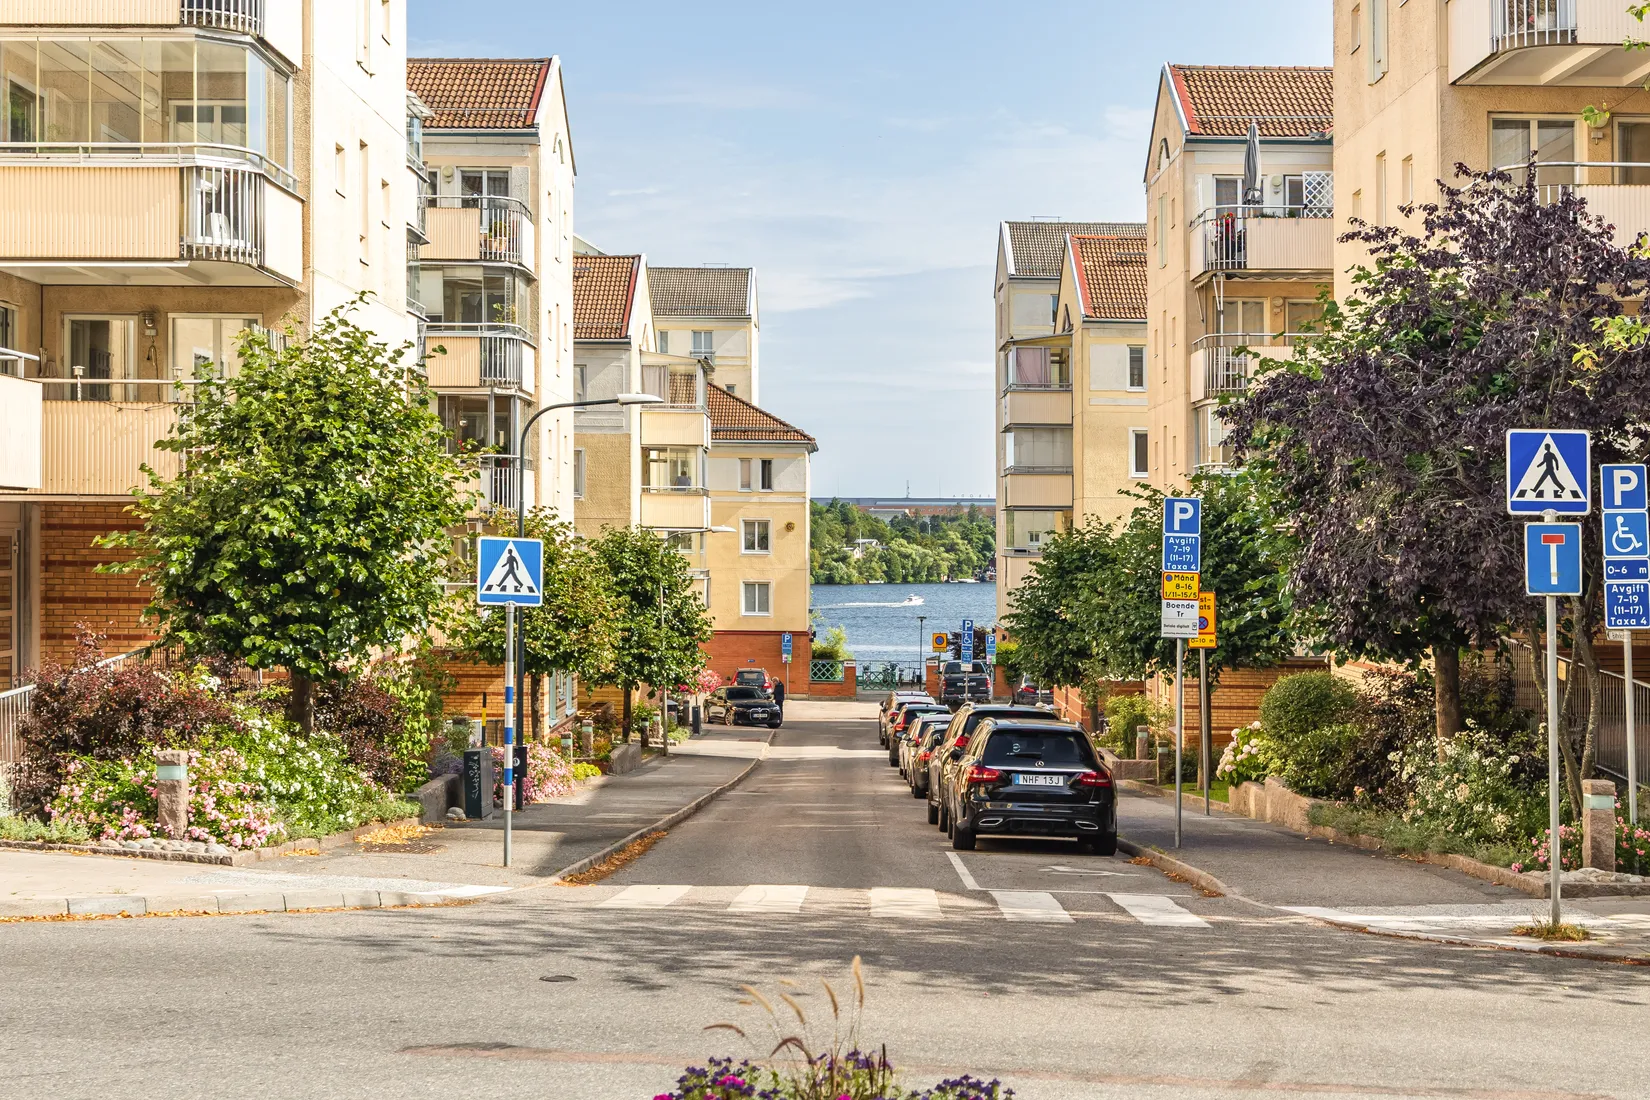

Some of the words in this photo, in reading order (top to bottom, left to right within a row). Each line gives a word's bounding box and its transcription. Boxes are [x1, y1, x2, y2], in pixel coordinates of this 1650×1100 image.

[1613, 469, 1638, 506] P
[1173, 501, 1194, 531] P
[1168, 537, 1195, 546] Avgift
[1169, 554, 1194, 562] (11-17)
[1190, 563, 1196, 571] 4
[1607, 566, 1628, 575] 0-6
[1173, 574, 1195, 582] Månd
[1611, 584, 1645, 595] Avgift
[1616, 595, 1639, 604] 7-19
[1613, 605, 1643, 615] (11-17)
[964, 620, 972, 631] P
[1610, 617, 1637, 626] Taxa
[1640, 616, 1647, 625] 4
[784, 634, 791, 643] P
[988, 636, 994, 645] P
[1022, 776, 1040, 784] NHF
[1043, 776, 1060, 785] 13J
